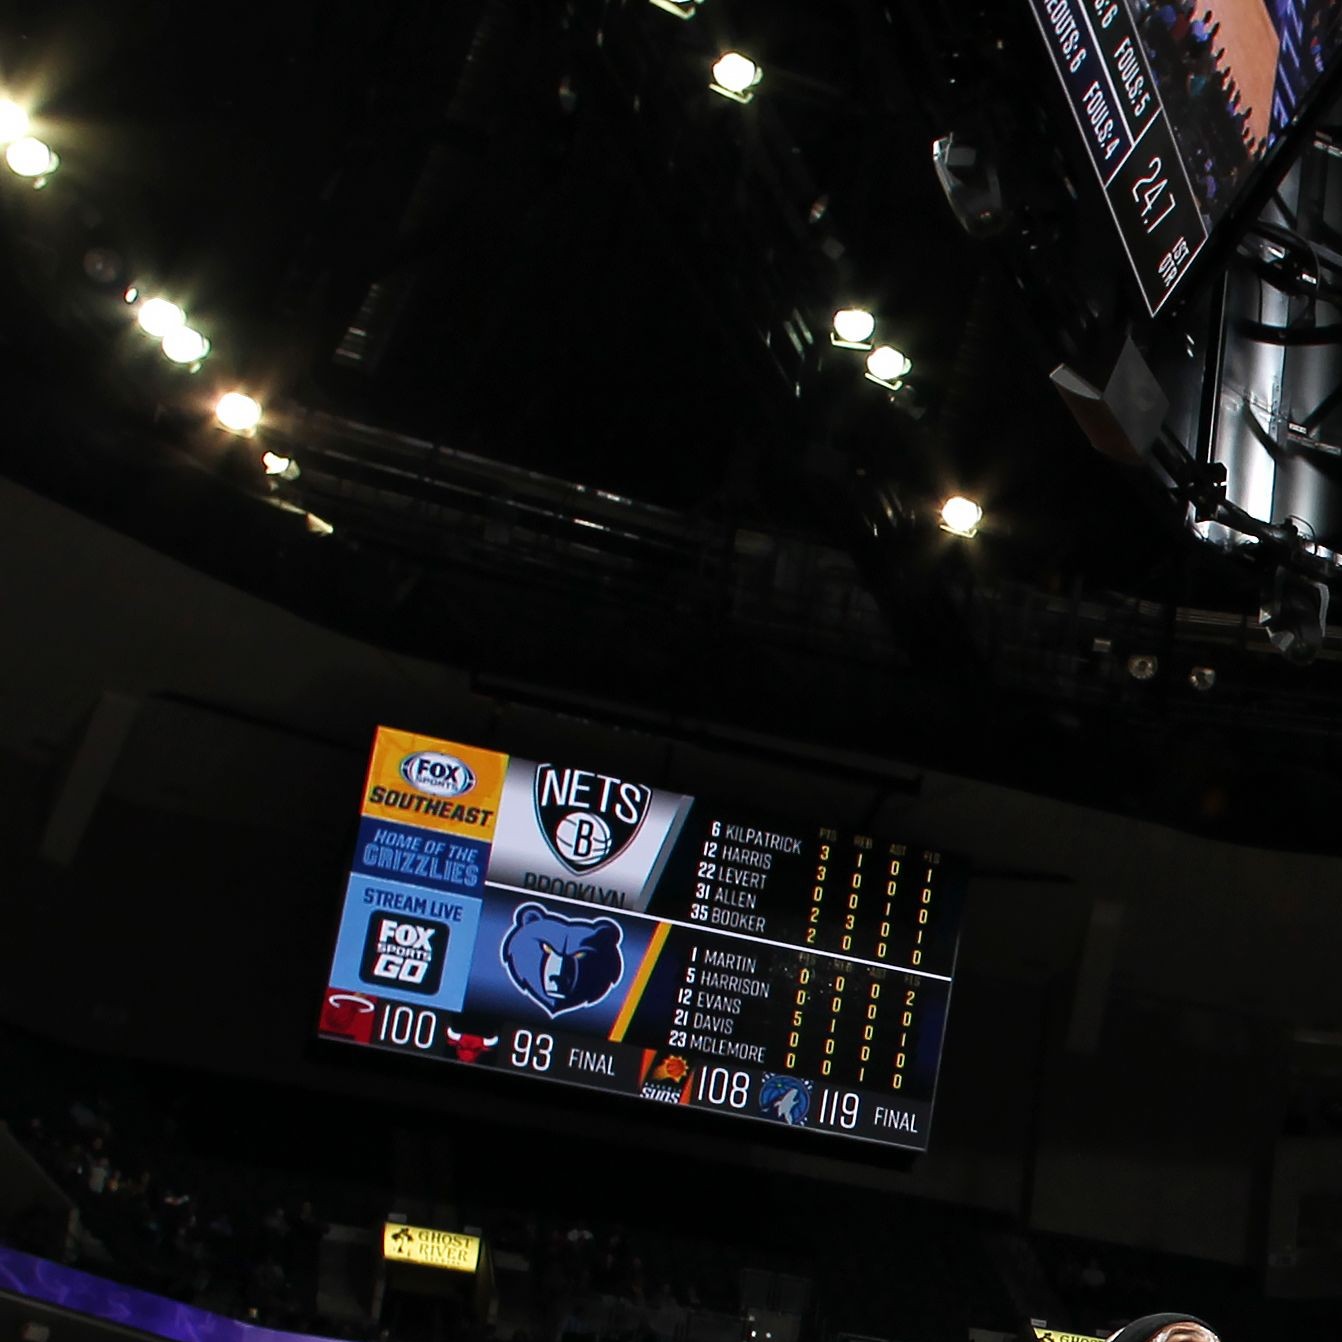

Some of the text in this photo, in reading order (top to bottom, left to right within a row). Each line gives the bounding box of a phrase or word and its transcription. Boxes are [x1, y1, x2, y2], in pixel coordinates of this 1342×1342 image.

[1101, 4, 1118, 29] 6
[1045, 0, 1087, 74] EOUTS: 6
[1113, 36, 1151, 118] FOULS: 5
[1082, 80, 1121, 161] FOULS: 4
[1132, 156, 1176, 234] 24.7
[415, 776, 458, 791] SPORTS
[417, 758, 460, 783] FOX
[369, 786, 494, 827] SOUTHEAST
[541, 768, 642, 825] NETS
[374, 828, 478, 864] HOME OF THE
[572, 819, 595, 857] B
[711, 820, 721, 838] 6
[725, 823, 803, 855] KILPATRICK
[362, 843, 480, 887] GRIZZLIES
[703, 841, 773, 870] 12 HARRIS
[698, 861, 768, 890] 22 LEVERT
[363, 887, 465, 923] STREAM LIVE
[695, 882, 757, 910] 31 ALLEN
[378, 918, 436, 949] FOX
[690, 903, 767, 933] 35 BOOKER
[377, 942, 432, 961] SPORTS
[703, 949, 758, 974] MARTIN
[373, 957, 430, 984] GO
[685, 967, 772, 998] 5 HARRISON
[677, 987, 743, 1015] 12 EVANS
[378, 1003, 438, 1049] 100
[673, 1009, 735, 1036] 21 DAVIS
[511, 1029, 616, 1077] 93 FINAL
[668, 1030, 767, 1064] 23 MCLEMORE
[697, 1064, 752, 1111] 108
[818, 1088, 919, 1134] 119 FINAL
[418, 1230, 473, 1248] GHOST
[419, 1243, 468, 1262] RIVER
